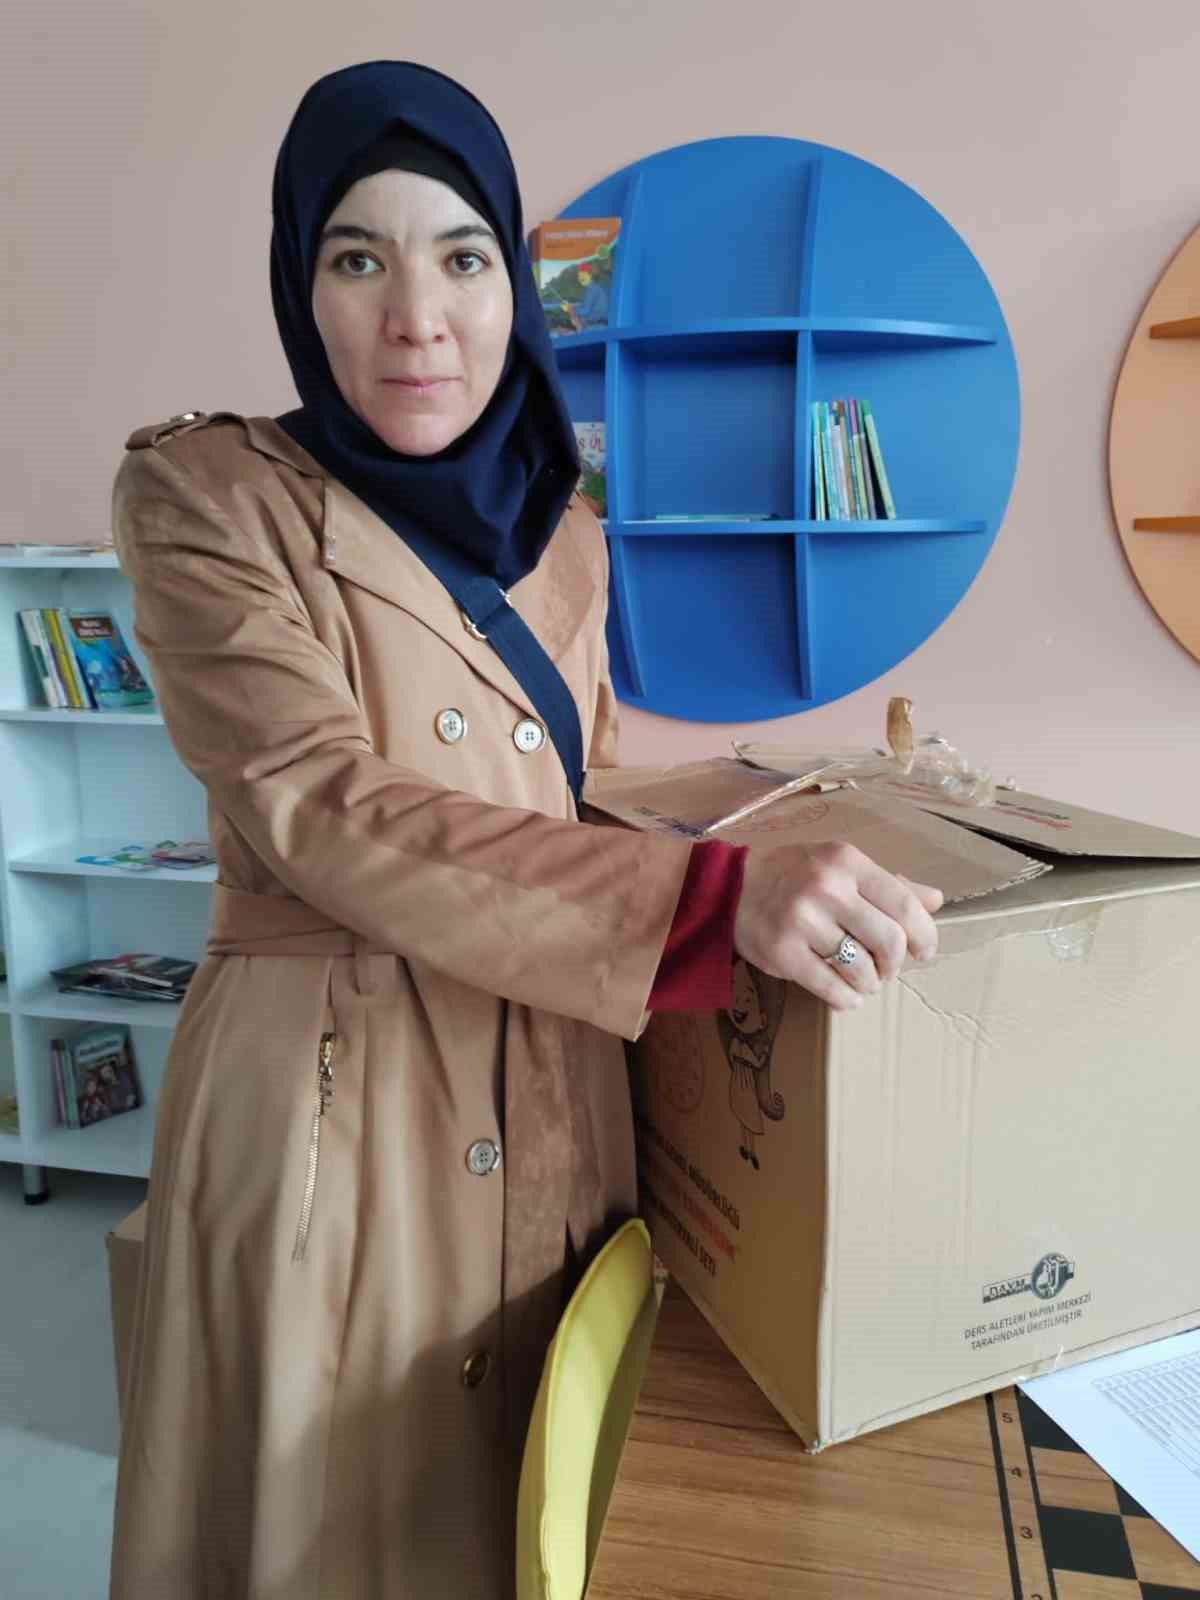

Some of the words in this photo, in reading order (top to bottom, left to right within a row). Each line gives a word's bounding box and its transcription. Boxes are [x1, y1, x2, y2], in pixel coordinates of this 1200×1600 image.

[964, 1324, 987, 1340] DERS
[970, 1326, 1026, 1351] TARAFINDAN
[1002, 1412, 1014, 1424] 5
[1010, 1466, 1023, 1478] 4
[1020, 1526, 1033, 1539] 3
